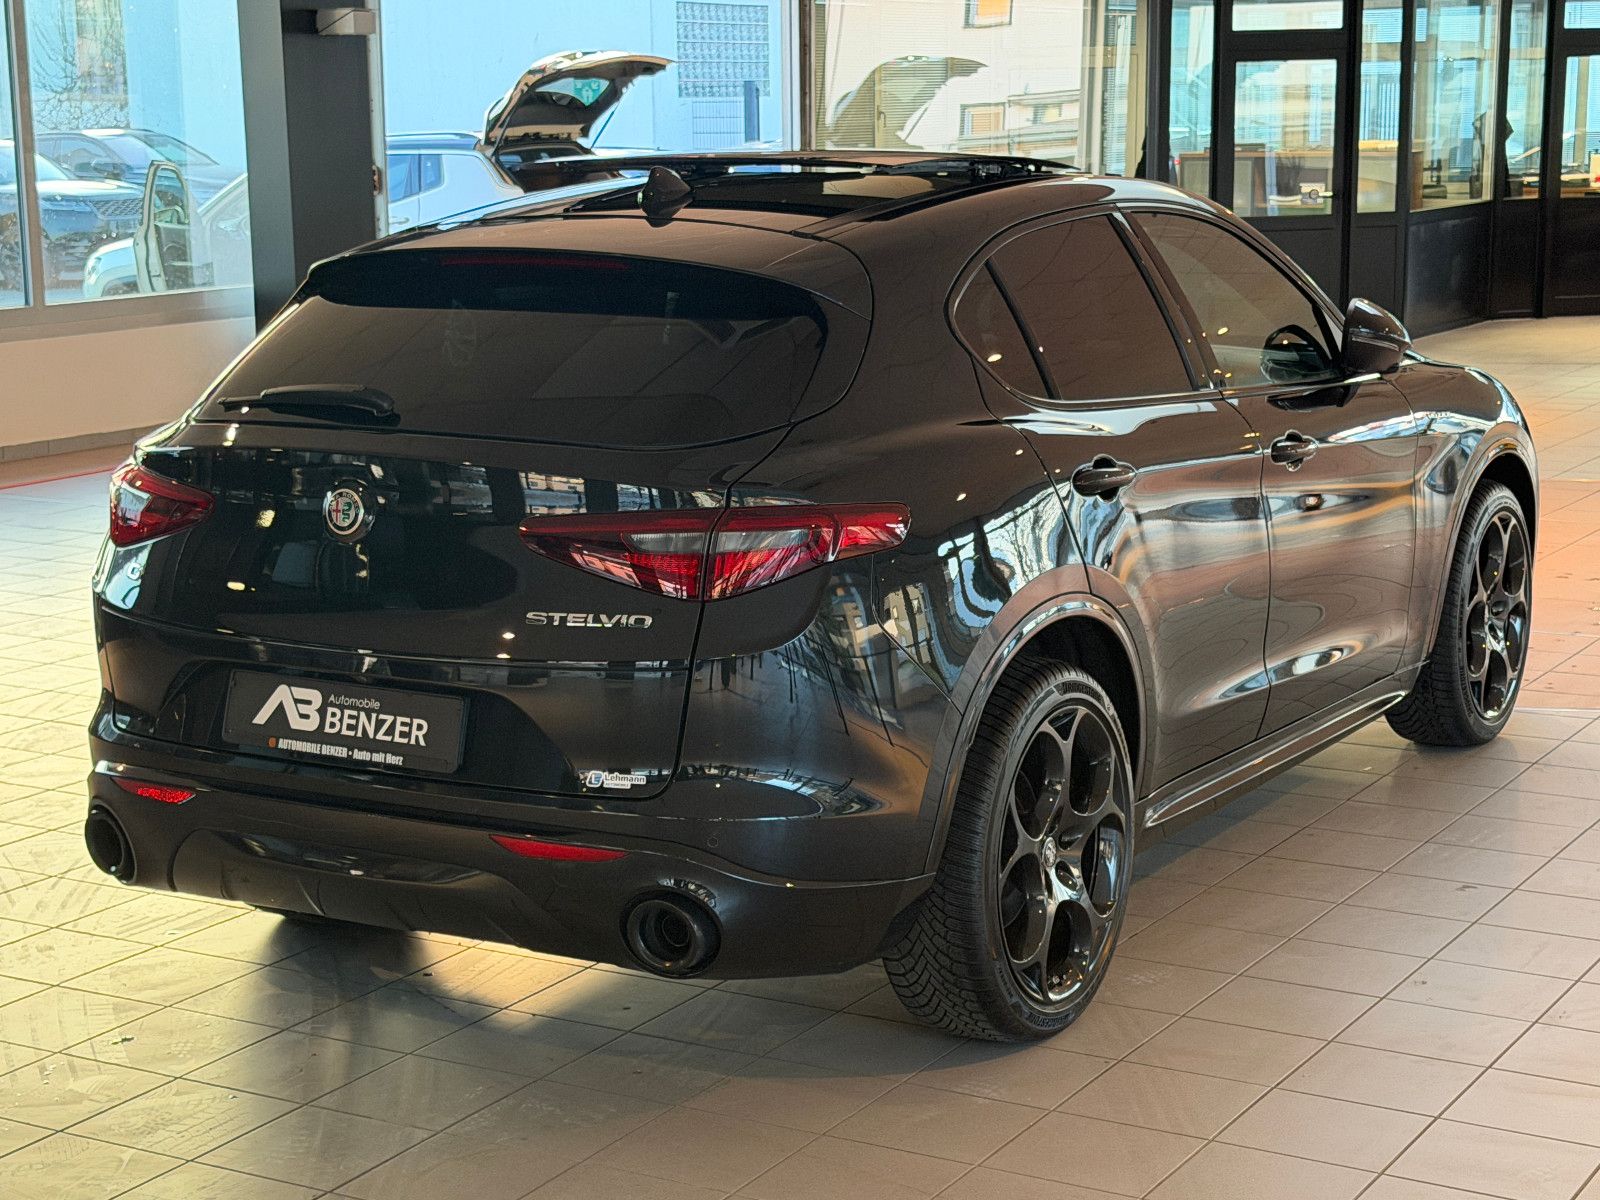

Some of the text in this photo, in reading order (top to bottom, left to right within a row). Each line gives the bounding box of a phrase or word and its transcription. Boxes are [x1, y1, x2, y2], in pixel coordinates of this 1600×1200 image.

[526, 611, 653, 629] STELVIO
[328, 694, 381, 709] Automobile
[324, 707, 429, 746] BENZER
[278, 738, 404, 766] AUTOMOBILE BENZER Auto mit Herz
[604, 773, 645, 783] Lehmann
